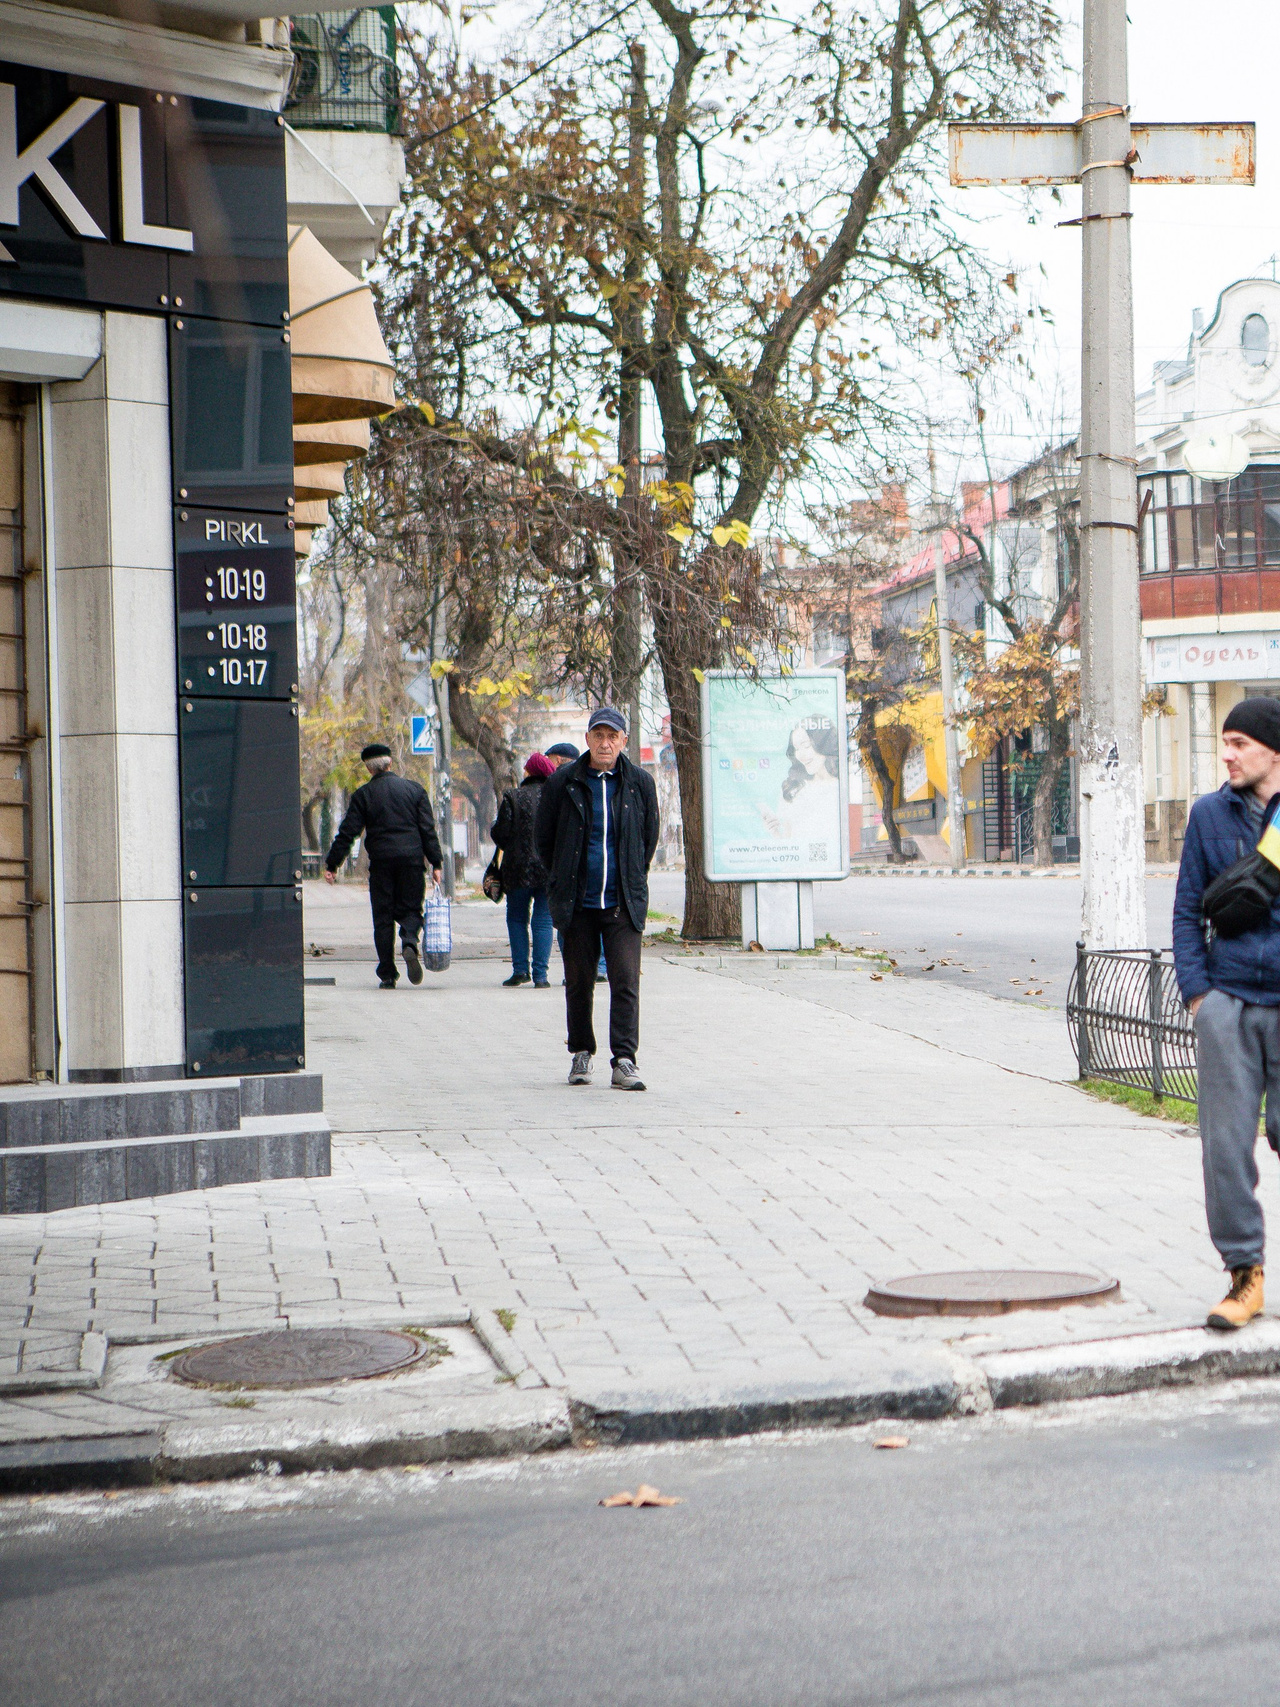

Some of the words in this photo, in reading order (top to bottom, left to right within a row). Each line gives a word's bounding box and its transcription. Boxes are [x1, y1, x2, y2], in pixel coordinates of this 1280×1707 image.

[0, 82, 193, 262] KL
[205, 518, 269, 548] PIRKL
[216, 566, 266, 601] 10-19
[218, 622, 267, 651] 10-18
[1185, 646, 1259, 667] Одель
[219, 657, 268, 686] 10-17
[729, 844, 800, 853] www.7telecom.ru
[779, 854, 800, 863] 0770
